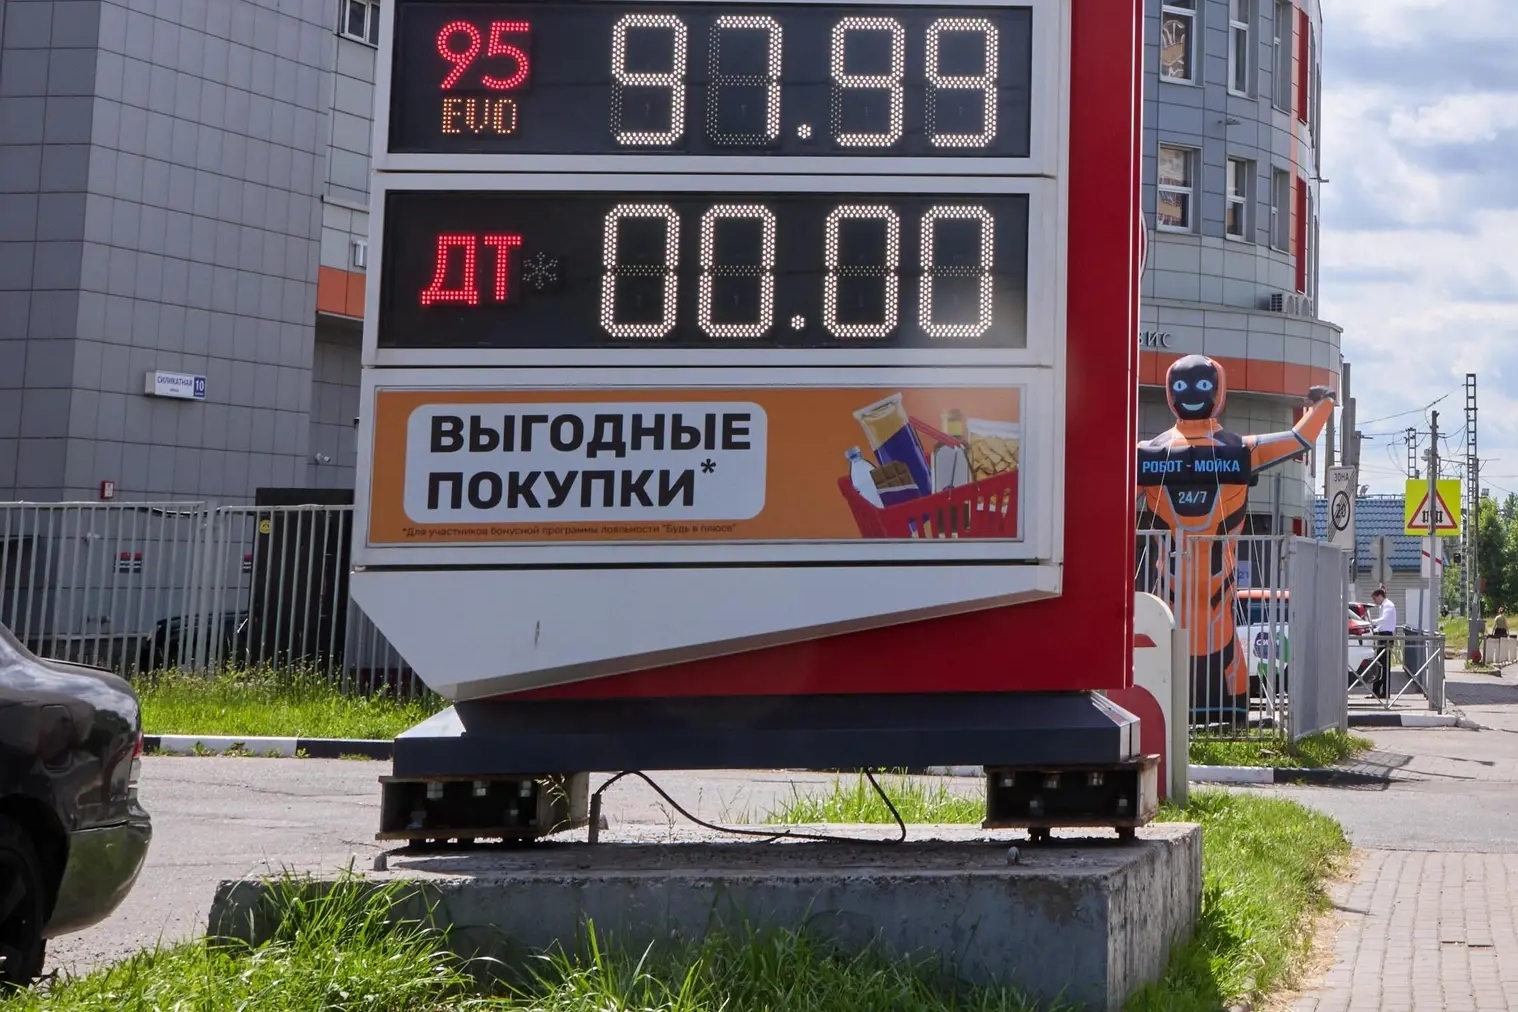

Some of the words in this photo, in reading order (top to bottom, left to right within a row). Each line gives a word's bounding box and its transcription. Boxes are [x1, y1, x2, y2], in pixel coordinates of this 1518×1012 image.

[436, 20, 530, 89] 95
[611, 13, 1000, 148] 97.99
[442, 98, 517, 134] EVO
[421, 235, 522, 305] ДТ
[600, 203, 995, 338] 00.00
[195, 379, 205, 392] 10
[429, 412, 752, 459] ВЫГОДНЫЕ
[1142, 459, 1183, 473] РОБОТ
[1194, 458, 1241, 473] МОЙКА
[1333, 472, 1349, 482] ЗОНА
[1178, 491, 1207, 504] 24/7
[1335, 503, 1347, 519] 20
[429, 528, 488, 537] участников
[490, 526, 539, 536] бонусной
[542, 525, 599, 536] программы
[601, 524, 660, 534] лояльности
